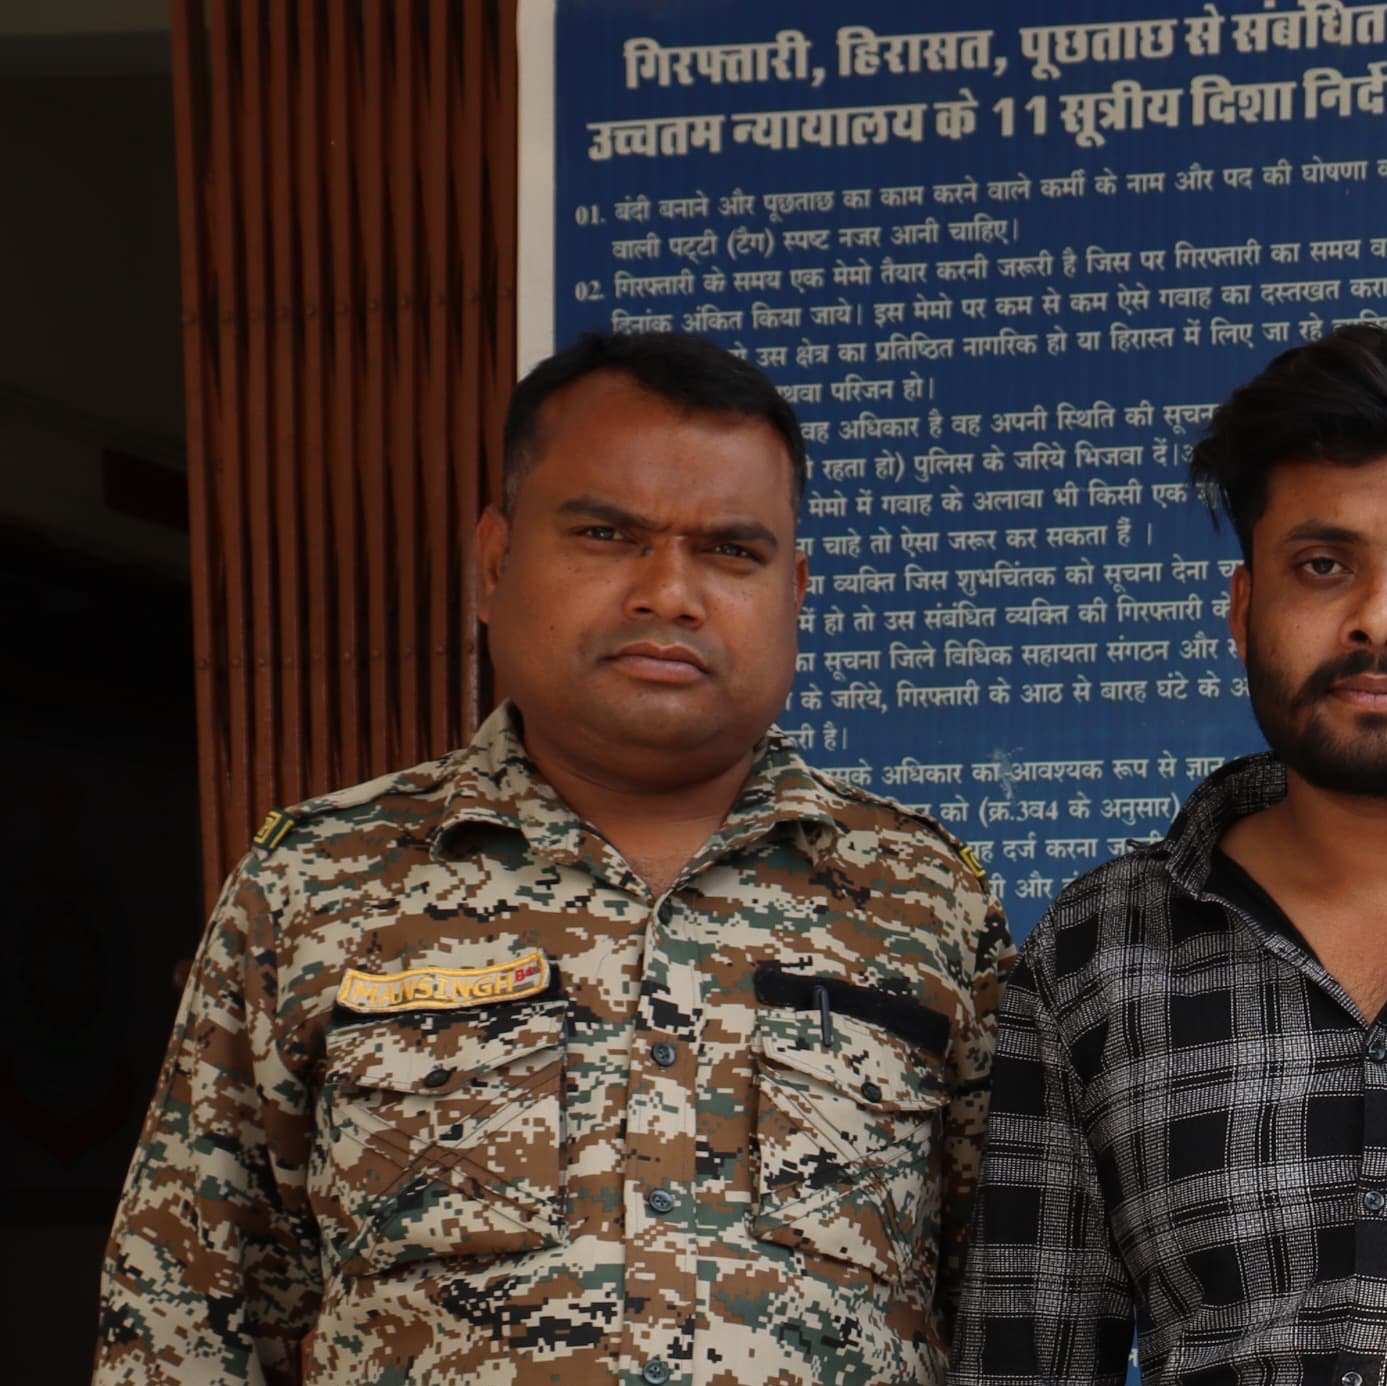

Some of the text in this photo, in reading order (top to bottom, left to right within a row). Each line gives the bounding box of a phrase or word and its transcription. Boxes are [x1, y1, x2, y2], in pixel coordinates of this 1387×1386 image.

[625, 31, 826, 90] गिरफ्तारी,
[838, 27, 1008, 77] हिरासत,
[1020, 20, 1178, 80] पूछताछ
[1185, 5, 1225, 56] से
[587, 116, 726, 161] उच्चतम
[733, 105, 928, 150] न्यायालय
[935, 89, 979, 140] के
[994, 97, 1047, 138] 11
[1192, 76, 1297, 126] दिशा
[660, 191, 710, 219] बनाने
[721, 189, 756, 216] और
[843, 190, 873, 209] का
[881, 187, 925, 207] काम
[934, 176, 979, 203] करने
[988, 173, 1033, 201] वाले
[1095, 169, 1119, 196] के
[1127, 174, 1166, 194] नाम
[1176, 163, 1215, 191] और
[1224, 169, 1254, 190] पद
[1263, 159, 1293, 186] की
[1302, 156, 1369, 184] घोषणा
[824, 529, 862, 558] चाहे
[871, 528, 893, 553] तो
[1007, 530, 1038, 548] कर
[1047, 527, 1109, 547] सकता
[801, 685, 823, 710] के
[989, 678, 1012, 705] के
[1022, 685, 1064, 704] आठ
[1073, 676, 1093, 703] से
[1199, 671, 1222, 698] के
[352, 974, 514, 1005] MANSINGH
